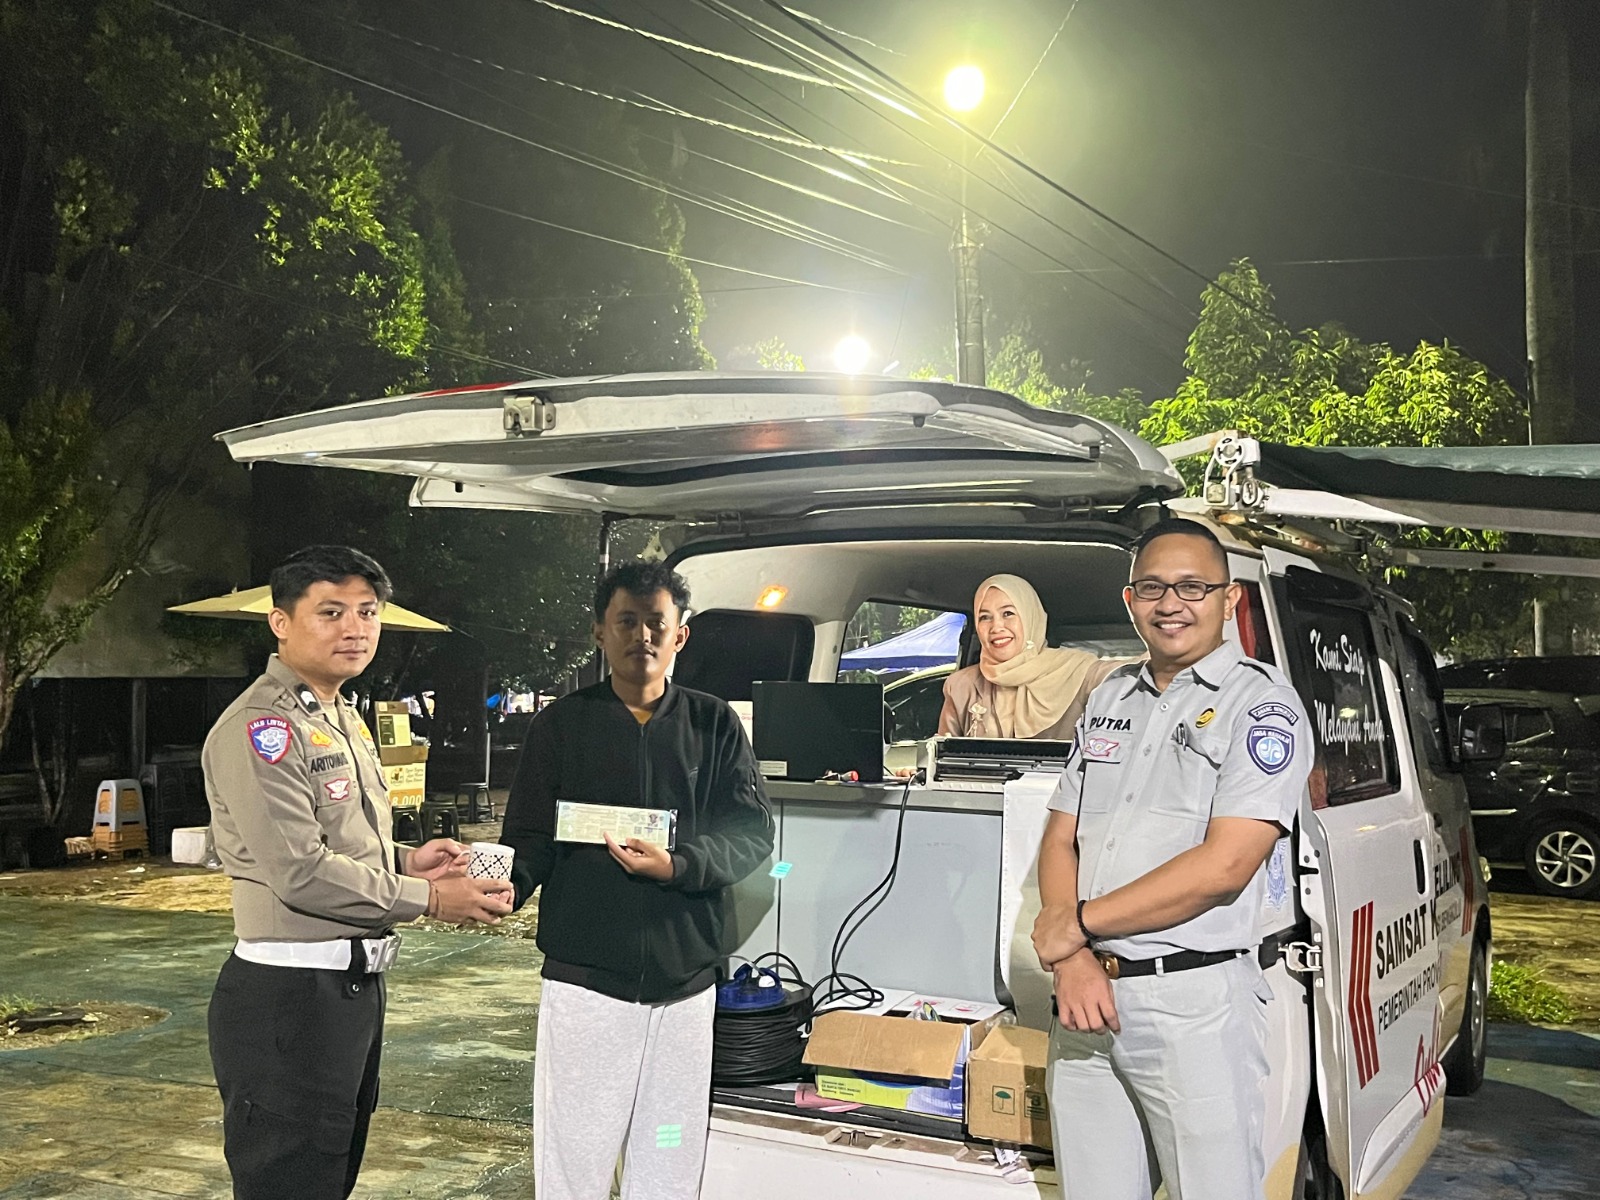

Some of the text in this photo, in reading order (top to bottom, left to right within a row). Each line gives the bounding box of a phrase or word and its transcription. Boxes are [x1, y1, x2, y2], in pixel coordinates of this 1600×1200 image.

[1310, 629, 1365, 686] Kami Siap
[249, 719, 287, 730] LALU LINTAS
[1089, 717, 1131, 731] PUTRA
[1314, 699, 1361, 756] Melayani
[392, 794, 422, 806] 8000
[1375, 903, 1426, 979] SAMSAT
[1378, 972, 1422, 1035] PEMERINTAH
